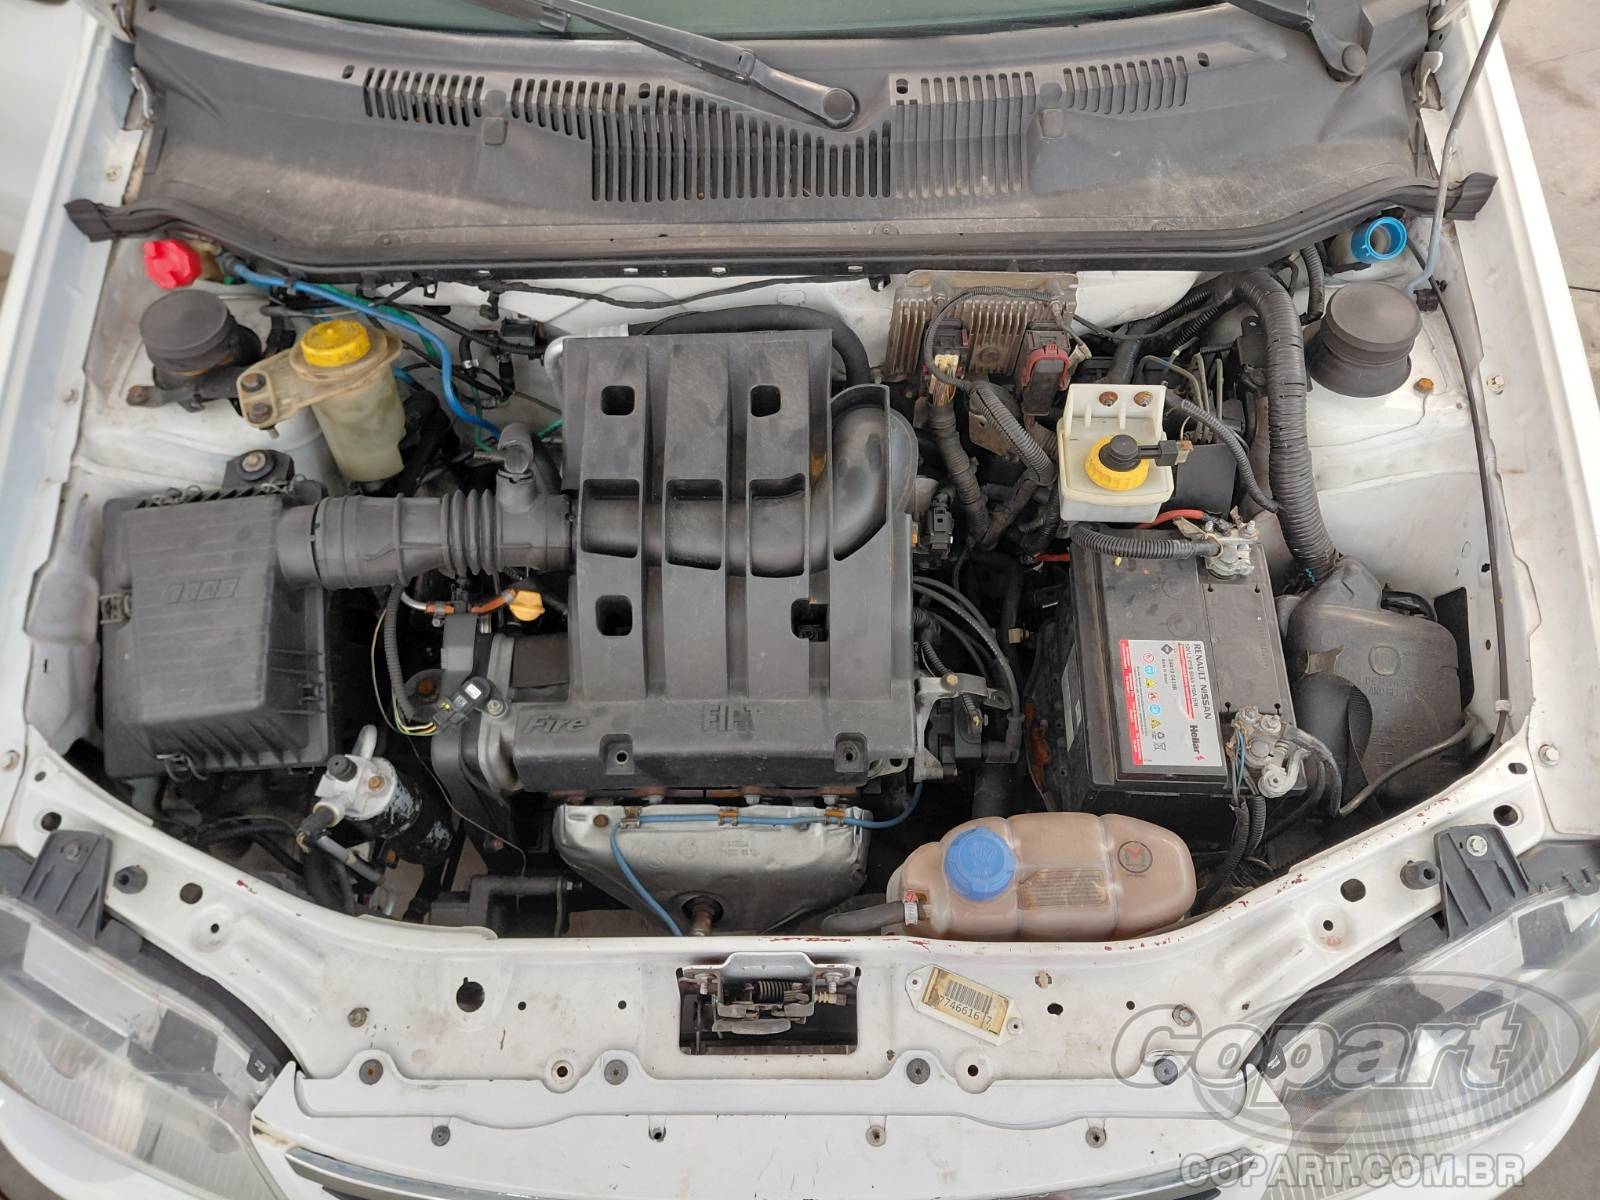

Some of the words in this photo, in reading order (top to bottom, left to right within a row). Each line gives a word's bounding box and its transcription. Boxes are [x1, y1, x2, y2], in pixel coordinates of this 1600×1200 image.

[1194, 643, 1206, 680] RENAULT
[1199, 684, 1212, 719] NISSAN
[523, 714, 588, 733] Fire
[1189, 724, 1201, 753] Heliar
[939, 995, 980, 1020] 7746616
